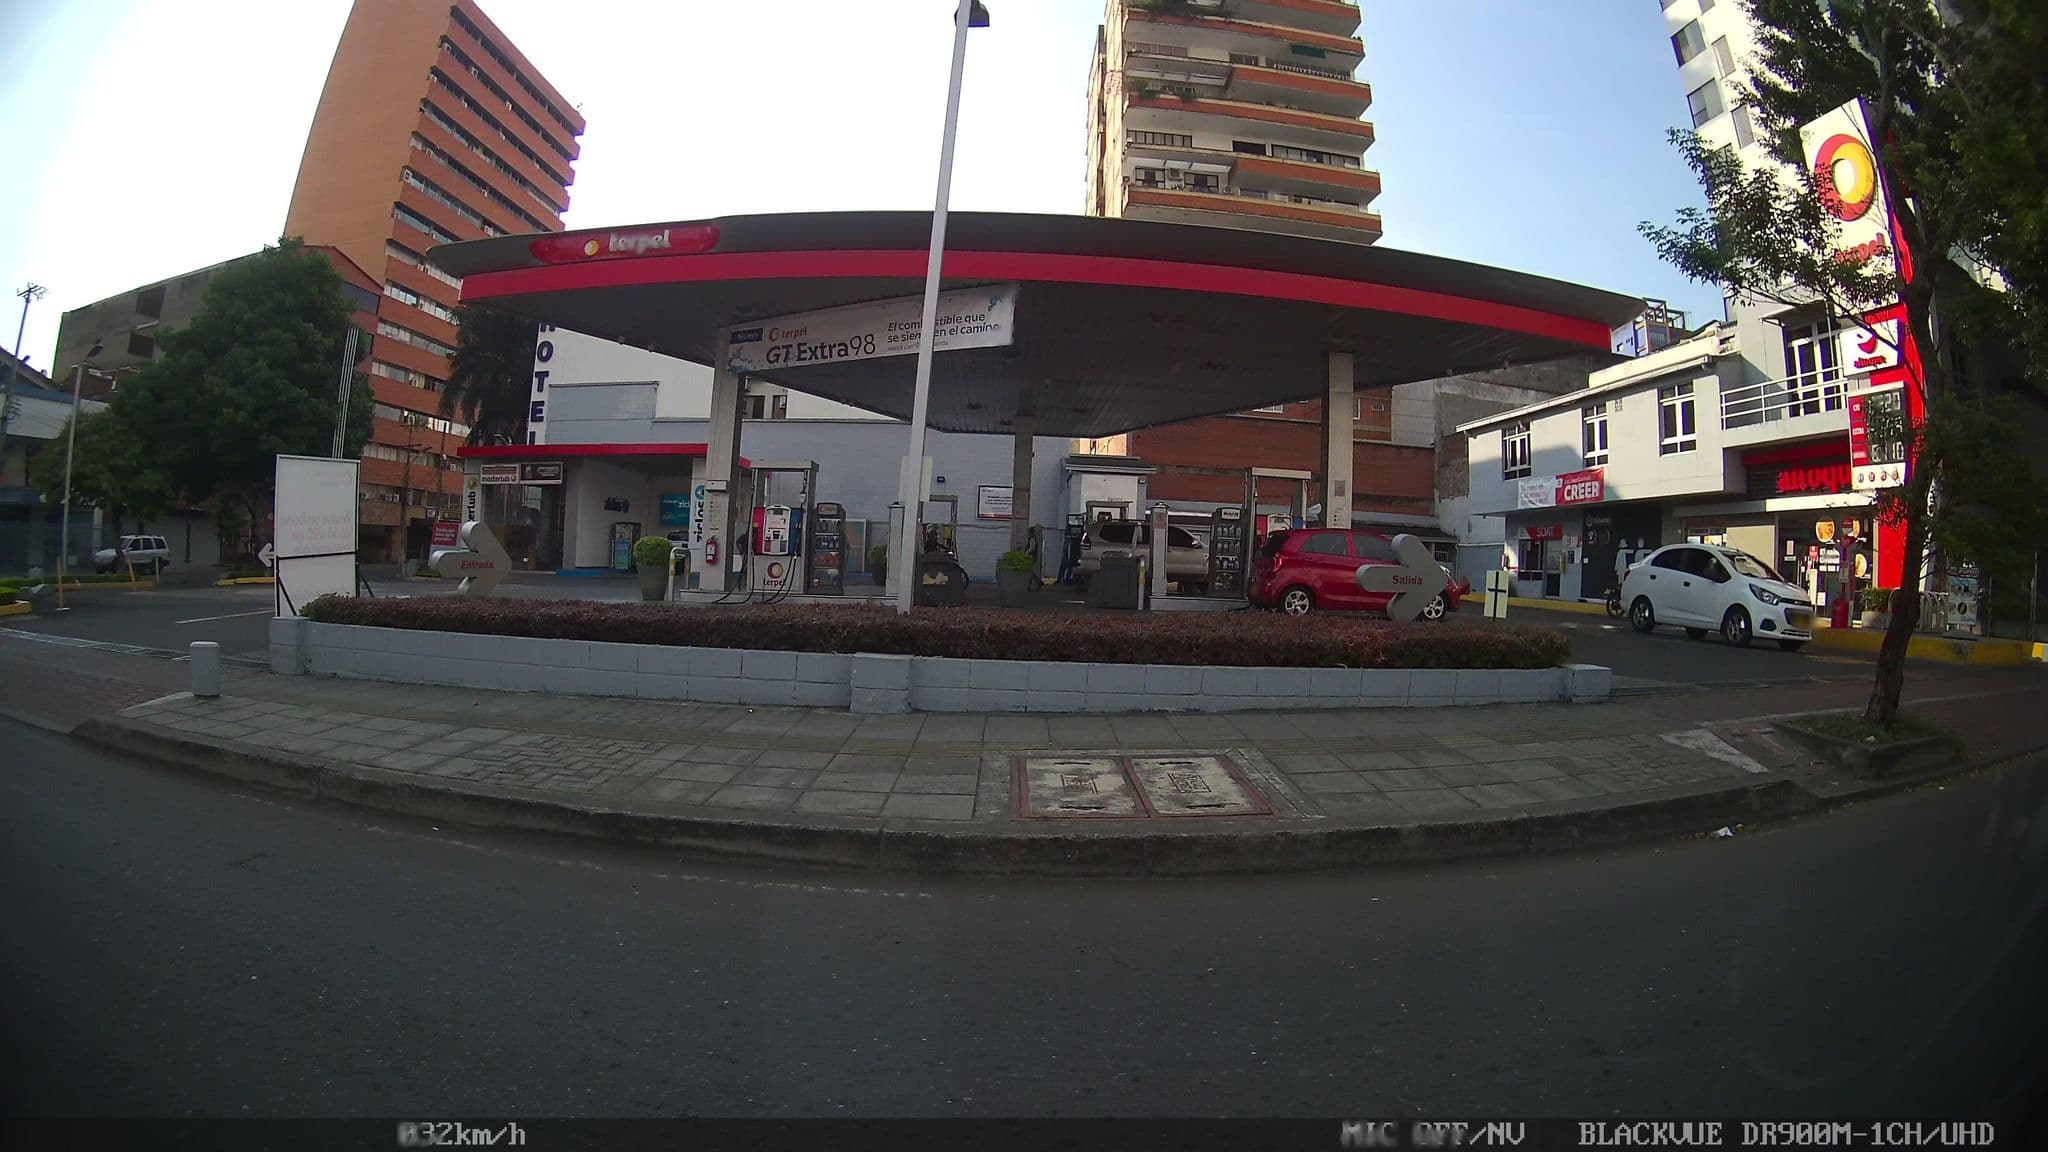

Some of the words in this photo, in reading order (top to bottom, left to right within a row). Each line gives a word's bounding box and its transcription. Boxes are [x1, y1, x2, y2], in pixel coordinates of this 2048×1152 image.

[888, 322, 897, 331] El
[900, 314, 962, 331] comstible
[964, 313, 985, 325] que
[782, 327, 808, 340] terpel
[888, 334, 899, 343] se
[949, 325, 958, 336] el
[766, 344, 793, 364] GT
[1776, 464, 1851, 493] altoqu
[1564, 480, 1600, 501] CREER
[1536, 526, 1554, 537] SOAT
[461, 559, 494, 569] Entrada
[1392, 574, 1423, 585] Salida
